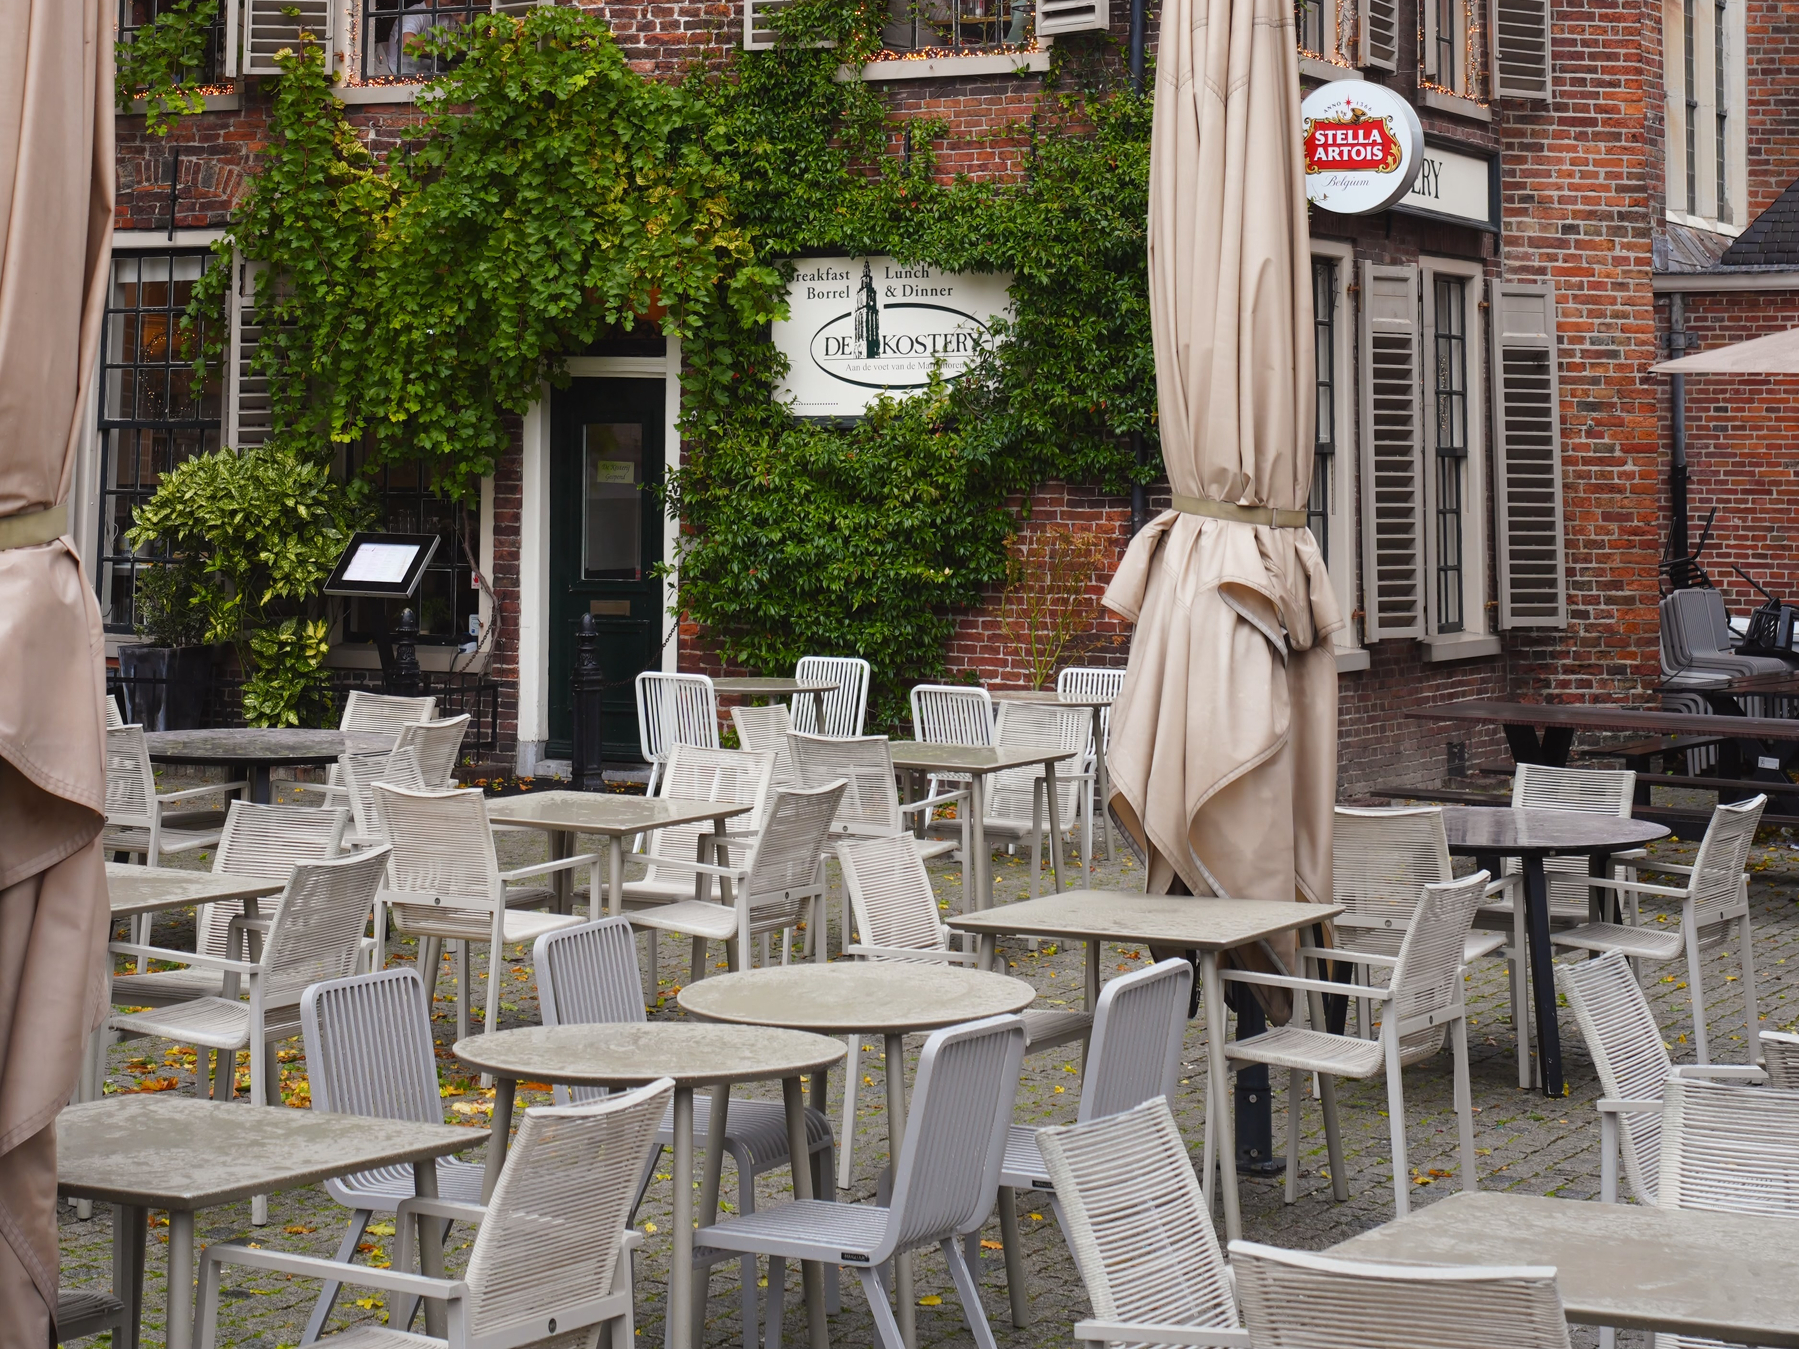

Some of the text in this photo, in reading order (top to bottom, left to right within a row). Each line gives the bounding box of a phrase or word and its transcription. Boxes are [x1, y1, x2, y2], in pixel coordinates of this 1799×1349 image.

[1323, 101, 1341, 113] ANNO
[1314, 129, 1383, 145] STELLA
[1313, 145, 1384, 161] ARTOIS
[1322, 175, 1369, 191] Belgium
[792, 264, 931, 283] reakfast Lunch
[806, 283, 954, 300] Borrel & Dinner
[824, 336, 853, 356] DE
[845, 363, 861, 372] Aan
[862, 362, 872, 371] de
[873, 363, 889, 371] voet
[891, 363, 905, 371] van
[906, 361, 916, 370] de
